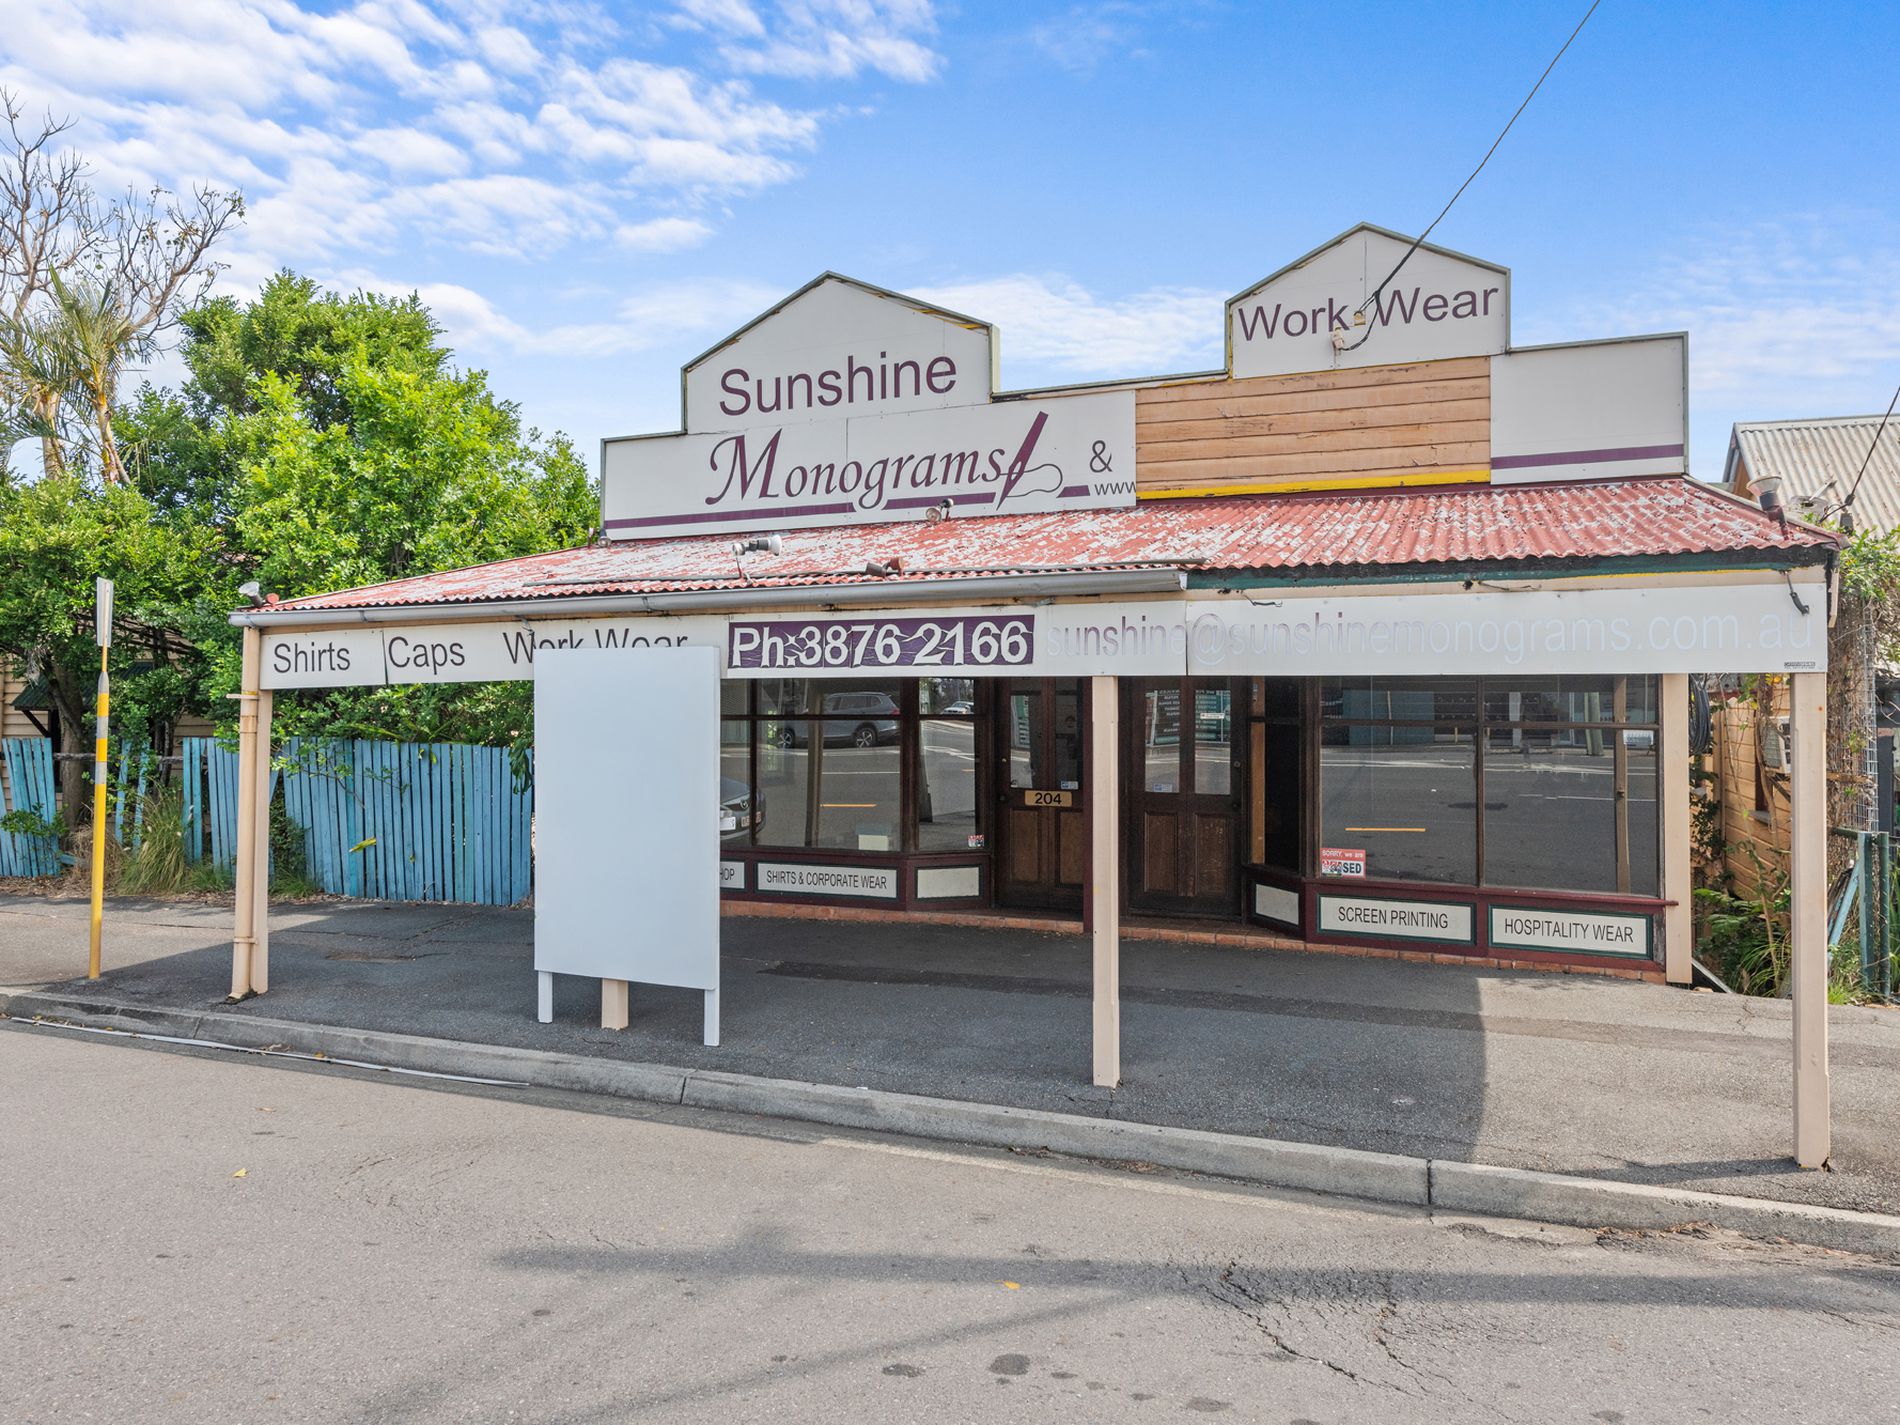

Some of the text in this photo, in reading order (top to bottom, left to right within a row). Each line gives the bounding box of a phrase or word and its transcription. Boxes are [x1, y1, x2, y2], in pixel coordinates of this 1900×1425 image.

[1237, 286, 1500, 342] Work Wear
[719, 350, 957, 417] Sunshine
[705, 427, 1113, 510] Monograms &
[273, 642, 351, 674] Shirts
[388, 635, 466, 676] Caps
[913, 619, 1029, 667] 2166
[1034, 792, 1062, 804] 204
[766, 870, 887, 889] SHIRTS & CORPORATE WEAR
[1338, 906, 1449, 929] SCREEN PRINTING
[1504, 918, 1634, 943] HOSPITALITY WEAR
